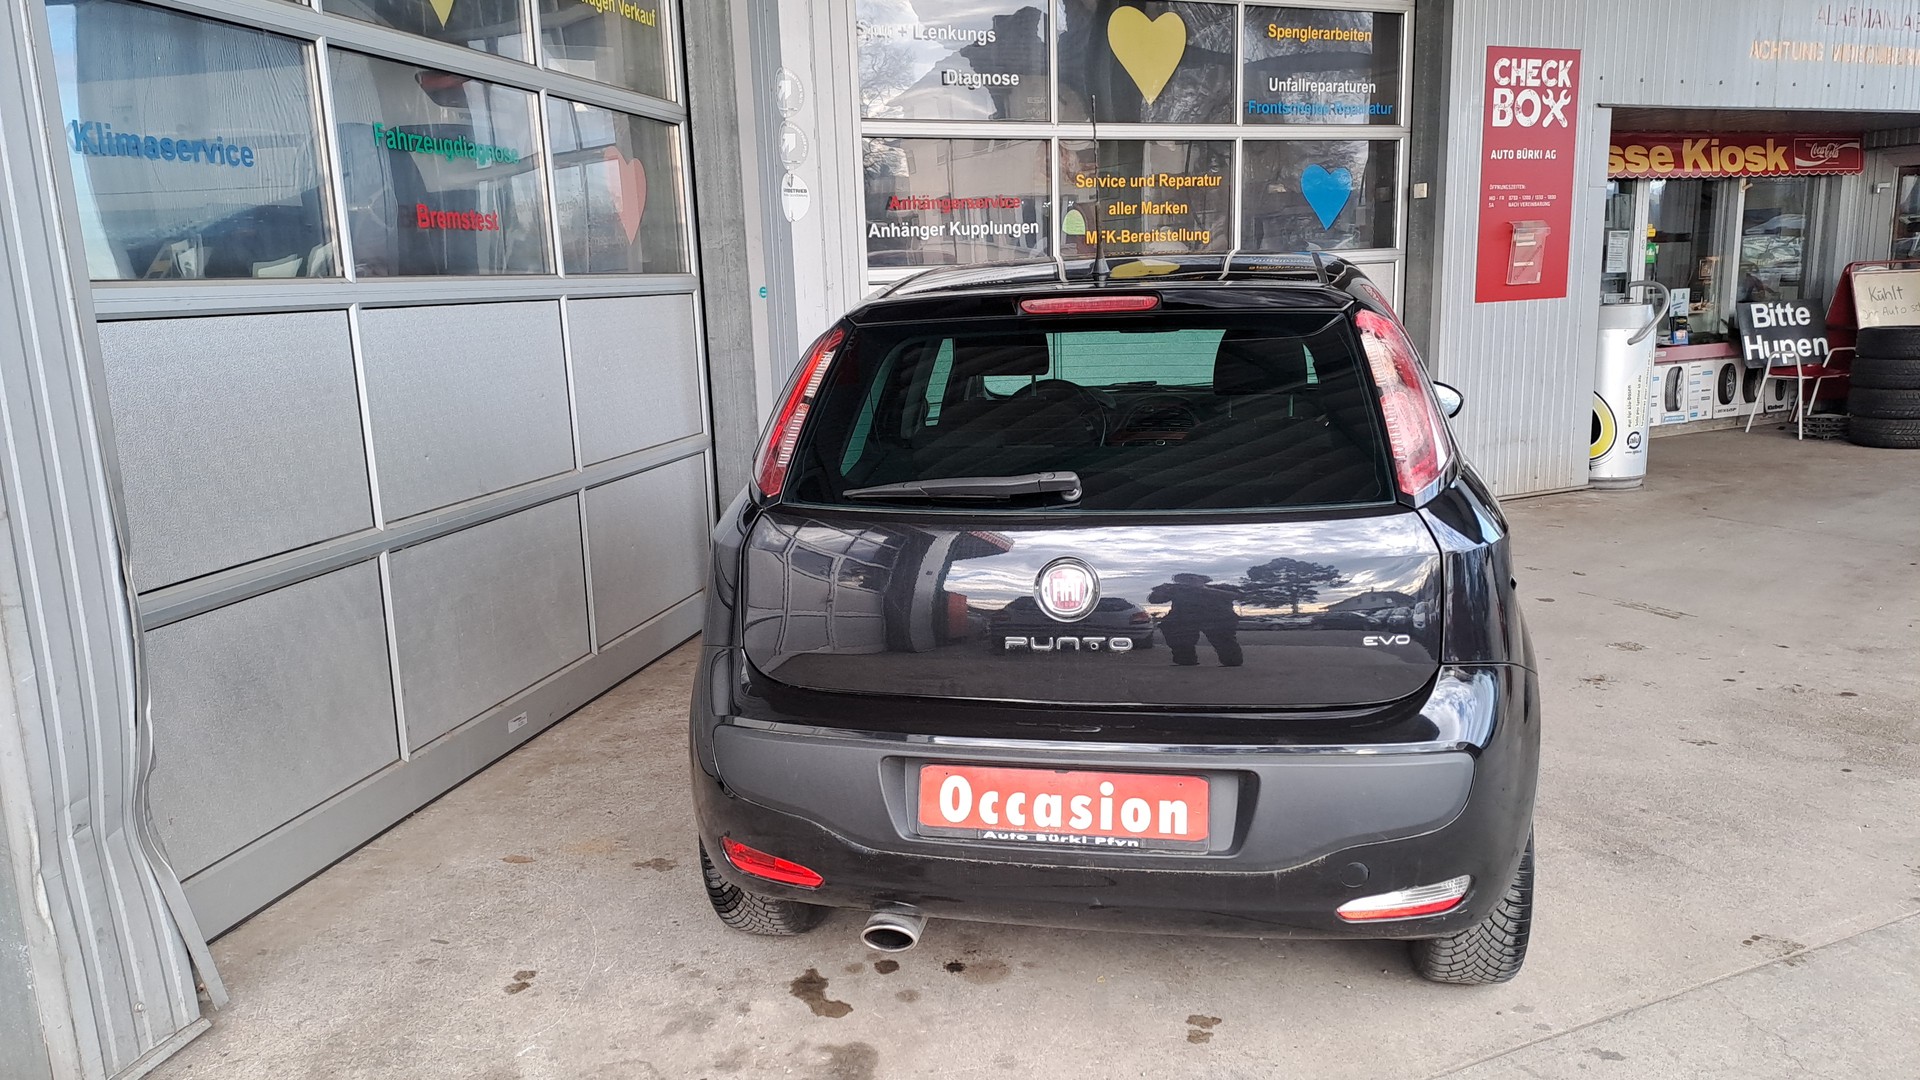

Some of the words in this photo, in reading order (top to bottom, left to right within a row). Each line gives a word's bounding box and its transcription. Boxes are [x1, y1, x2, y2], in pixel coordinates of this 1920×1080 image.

[582, 0, 616, 13] agen
[618, 0, 656, 27] Verkauf
[914, 25, 996, 46] Lenkungs
[1268, 23, 1373, 43] Spenglerarbeiten
[1749, 40, 1824, 62] ACHTUNG
[945, 69, 1020, 88] Diagnose
[1493, 57, 1573, 88] CHECK
[1268, 77, 1377, 95] Unfallreparaturen
[1491, 87, 1572, 128] BOX
[71, 119, 254, 168] Klimaservice
[373, 122, 520, 165] Fahrzeugdiagnose
[1490, 149, 1515, 160] AUTO
[1516, 148, 1543, 160] BÜRKI
[1544, 149, 1557, 160] AG
[1682, 138, 1790, 174] Kiosk
[1075, 173, 1127, 188] Service
[1130, 174, 1155, 188] und
[1158, 173, 1223, 190] Reparatur
[889, 194, 1021, 214] Anhängerservice
[1108, 202, 1138, 215] aller
[1141, 201, 1188, 215] Marken
[416, 203, 500, 231] Bremstest
[868, 222, 946, 240] Anhänger
[949, 220, 1039, 240] Kupplungen
[1867, 285, 1904, 302] Kühlt
[1750, 302, 1811, 329] Bitte
[1882, 305, 1907, 316] Auto
[1743, 334, 1829, 365] Hupen
[1004, 635, 1134, 651] PUNTO
[1362, 634, 1411, 646] EVO
[939, 774, 1188, 836] Occasion
[982, 830, 1029, 841] Auto
[1035, 832, 1088, 844] Bürki
